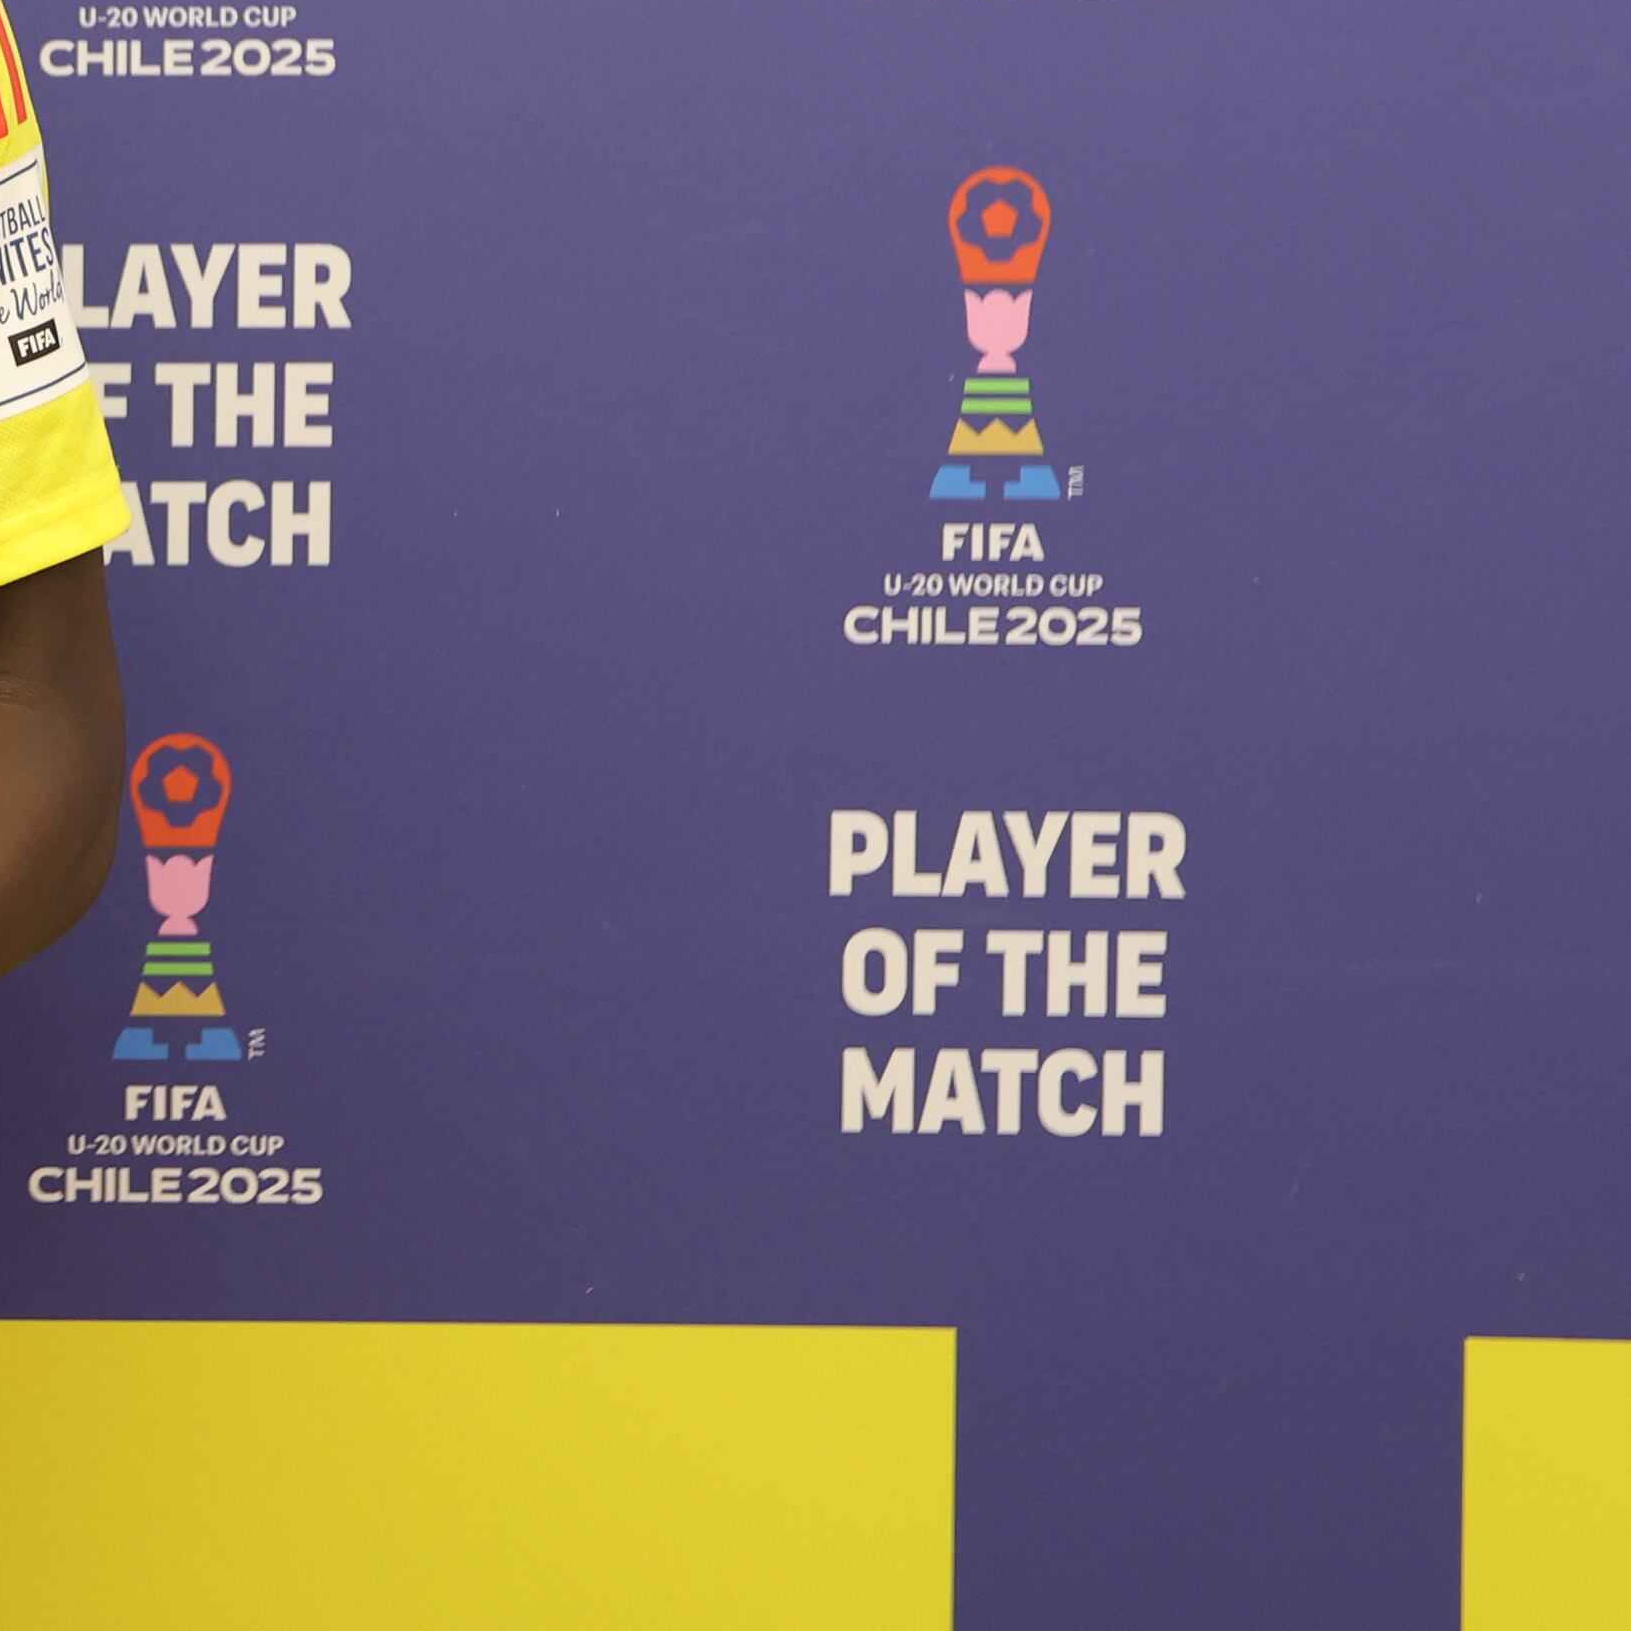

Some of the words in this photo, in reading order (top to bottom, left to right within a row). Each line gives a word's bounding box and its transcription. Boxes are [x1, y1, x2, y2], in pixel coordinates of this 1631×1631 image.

[79, 6, 139, 28] U-20
[143, 6, 239, 28] WORLD
[243, 5, 297, 28] CUP
[61, 244, 352, 330] LAYER
[16, 327, 56, 358] FIFA
[155, 362, 333, 447] THE
[104, 479, 331, 567] ATCH
[942, 523, 1045, 562] FIFA
[884, 573, 944, 596] U-20
[948, 573, 1045, 597] WORLD
[1049, 573, 1104, 597] CUP
[829, 809, 1187, 900] PLAYER
[842, 927, 964, 1016] OF
[985, 929, 1168, 1018] THE
[125, 1085, 227, 1122] FIFA
[841, 1047, 1165, 1137] MATCH
[68, 1134, 127, 1155] U-20
[131, 1134, 227, 1156] WORLD
[230, 1134, 285, 1156] CUP
